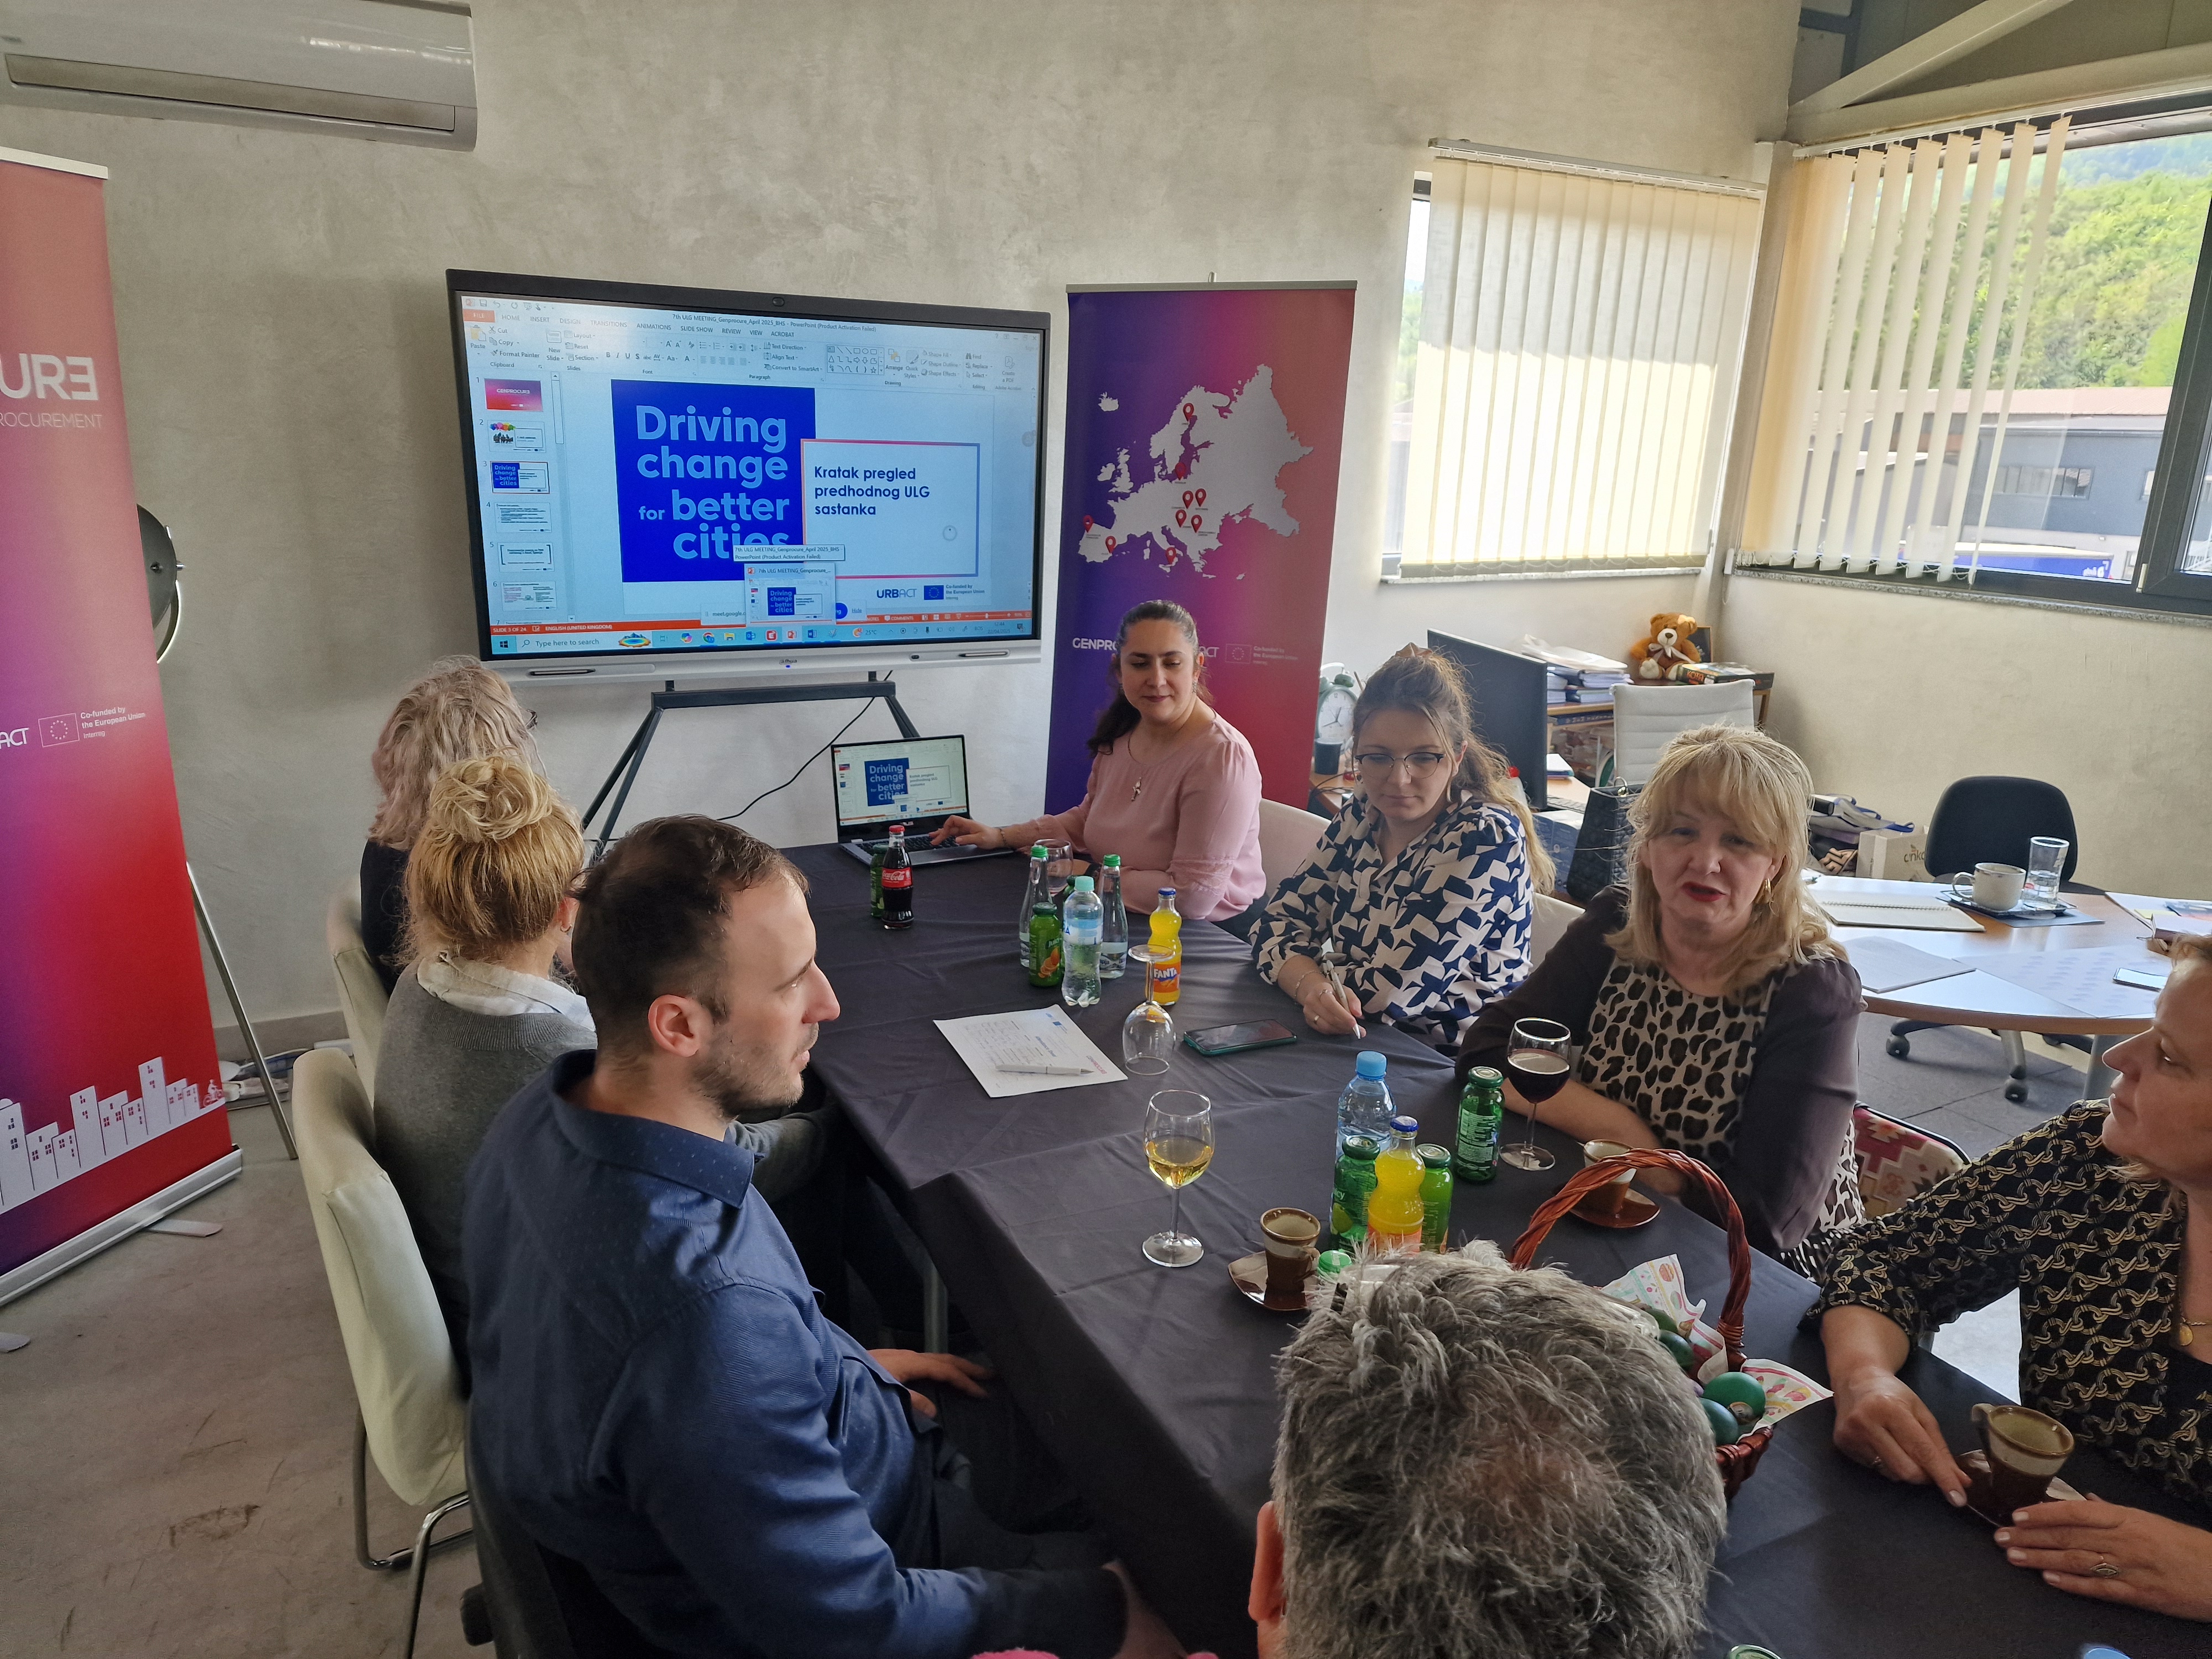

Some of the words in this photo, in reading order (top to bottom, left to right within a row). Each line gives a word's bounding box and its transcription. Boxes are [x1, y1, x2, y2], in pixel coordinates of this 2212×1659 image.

[636, 405, 786, 452] Driving
[637, 445, 787, 488] change
[815, 466, 859, 479] Kratak
[863, 466, 916, 483] pregled
[815, 485, 900, 500] predhodnog
[904, 486, 930, 498] ULG
[639, 505, 664, 520] for
[672, 489, 789, 521] better
[815, 504, 876, 515] sastanka
[877, 588, 917, 598] URBACT
[81, 708, 116, 719] Co-funded
[95, 715, 127, 727] European
[128, 712, 145, 720] Union
[84, 731, 105, 739] Interreg
[869, 764, 903, 774] Driving
[870, 774, 904, 783] change
[878, 783, 905, 792] better
[1154, 967, 1177, 978] FANTA
